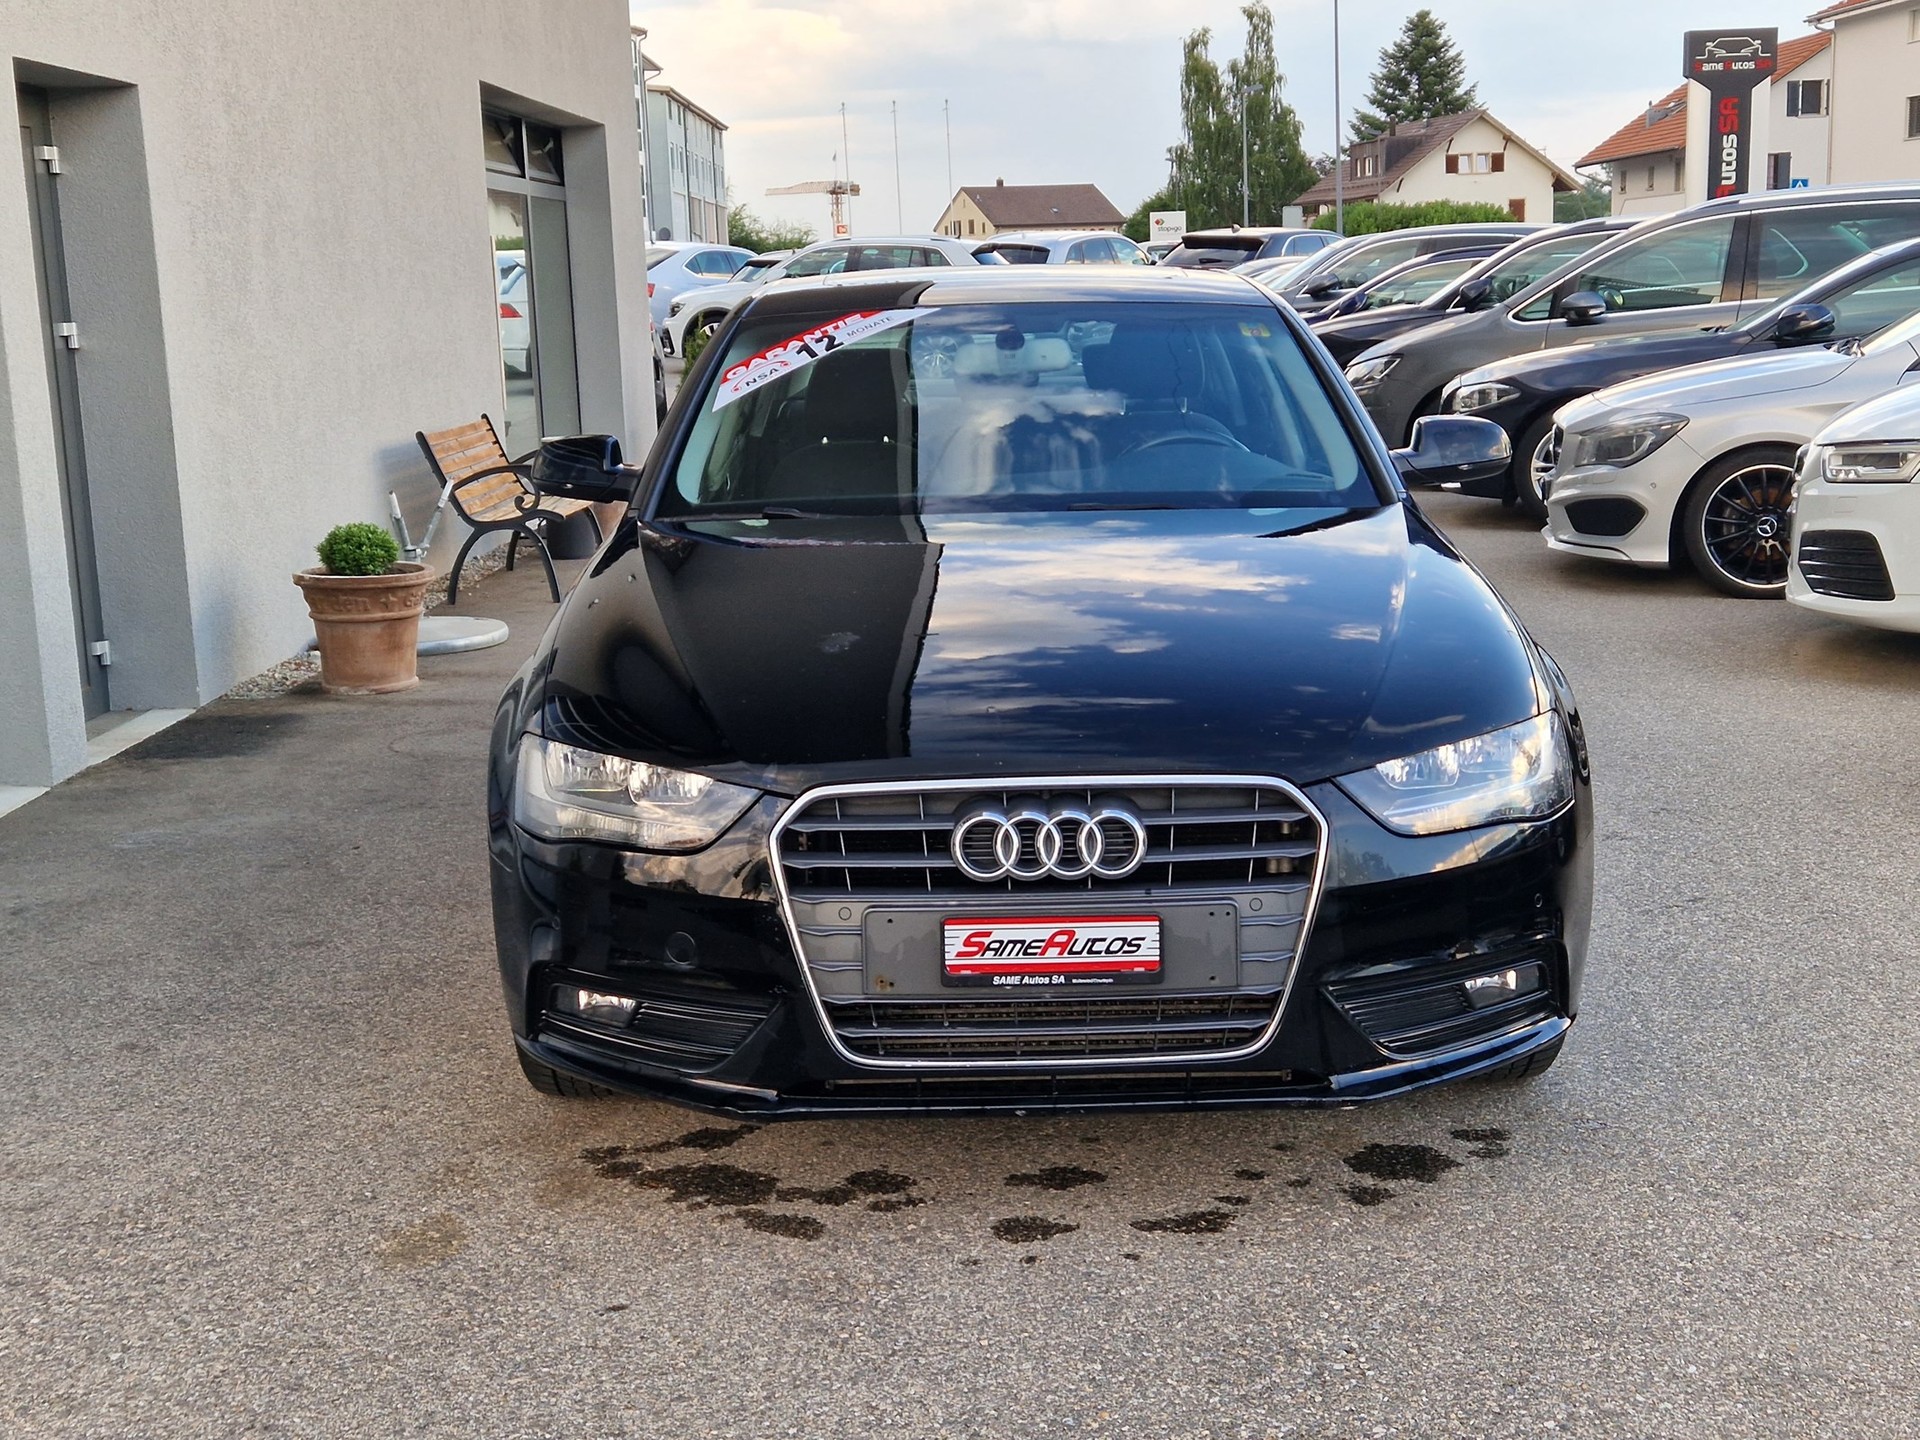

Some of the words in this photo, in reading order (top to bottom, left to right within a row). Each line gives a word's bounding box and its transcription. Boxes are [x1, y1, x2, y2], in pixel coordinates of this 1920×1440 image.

[846, 316, 893, 338] MONATE
[726, 313, 864, 380] GARANTIE
[796, 334, 844, 359] 12
[745, 367, 779, 387] NSA
[993, 975, 1021, 985] SAME
[1022, 975, 1050, 985] Autos
[1051, 974, 1065, 984] SA
